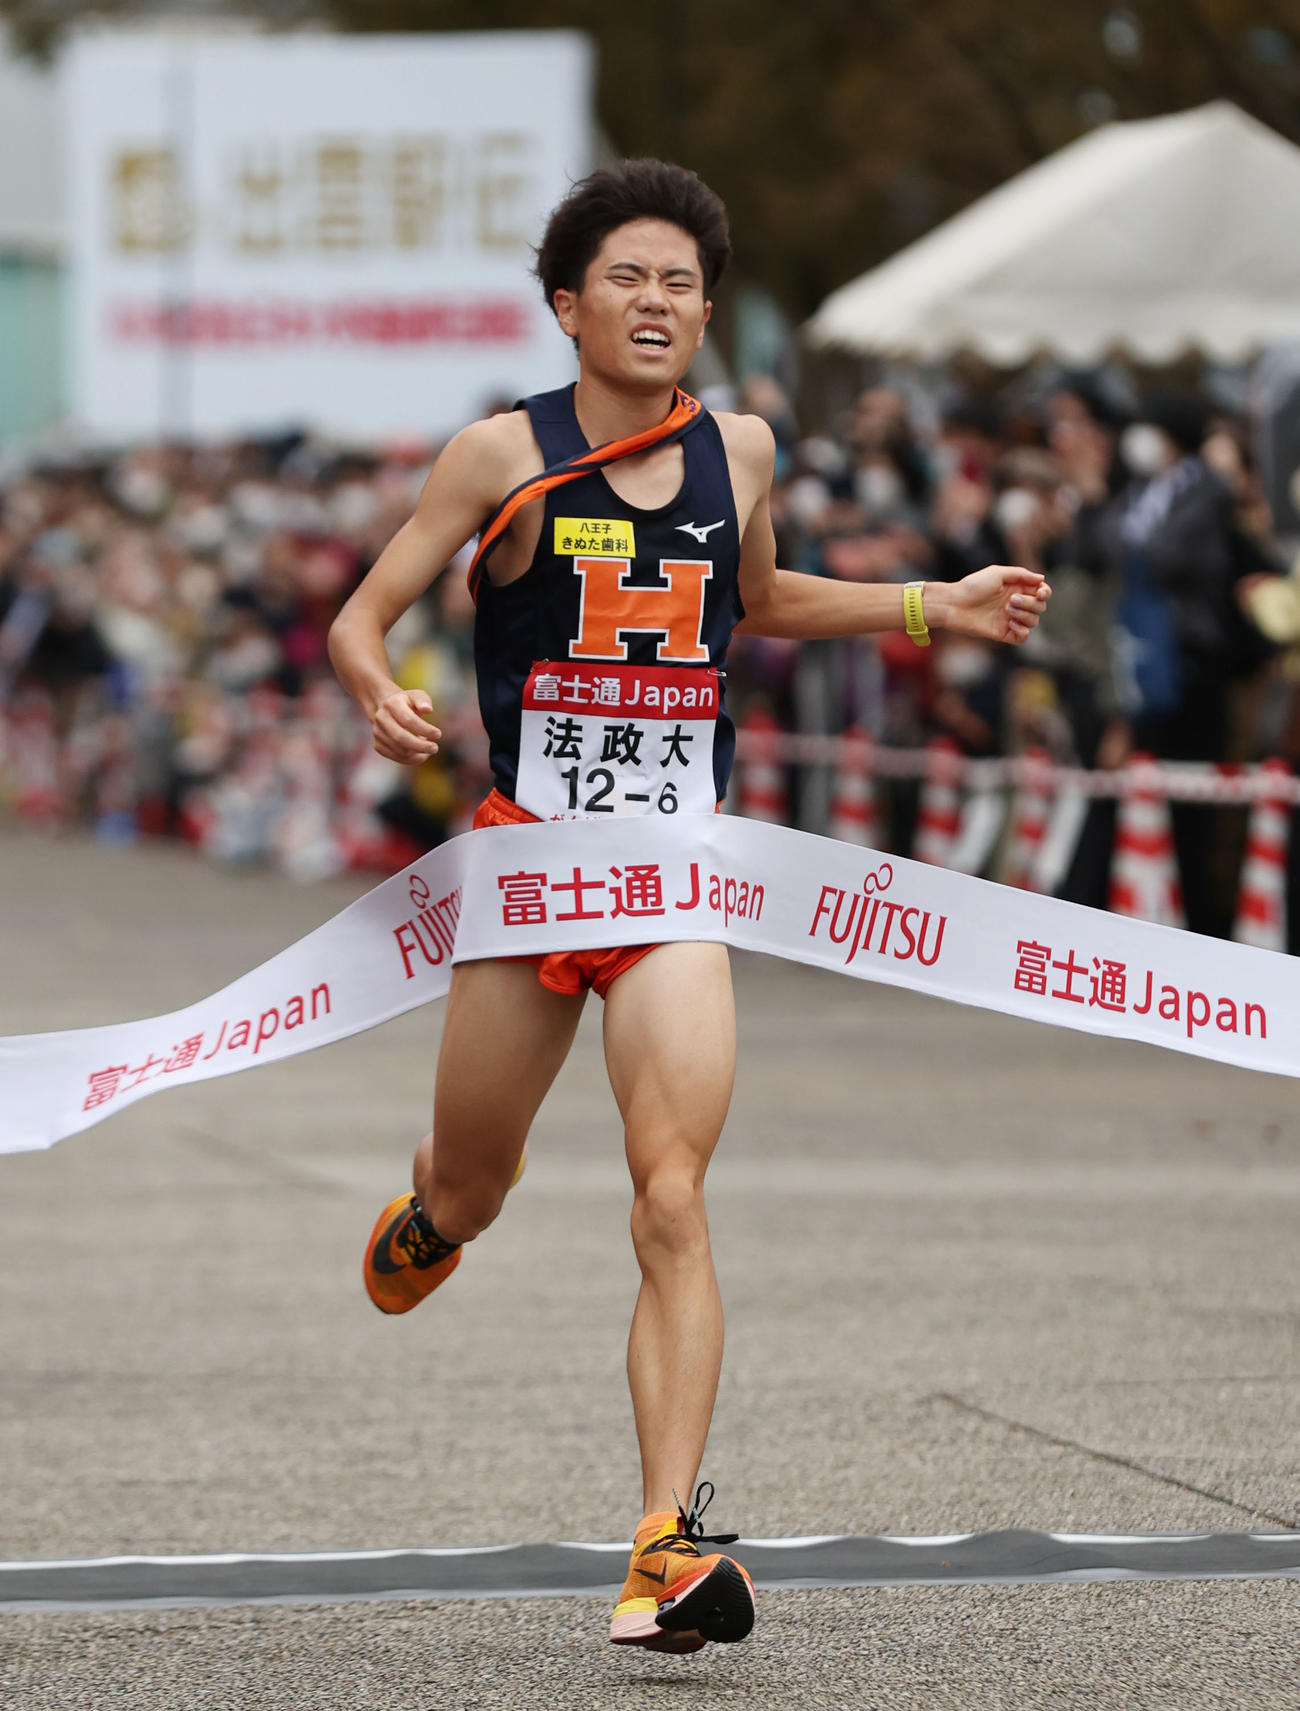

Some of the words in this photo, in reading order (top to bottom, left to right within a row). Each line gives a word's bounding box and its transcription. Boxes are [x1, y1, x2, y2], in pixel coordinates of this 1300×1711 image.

[562, 537, 628, 553] きぬた歯科
[579, 522, 612, 534] 八王子
[569, 556, 713, 662] H
[808, 863, 948, 967] FUJITSU
